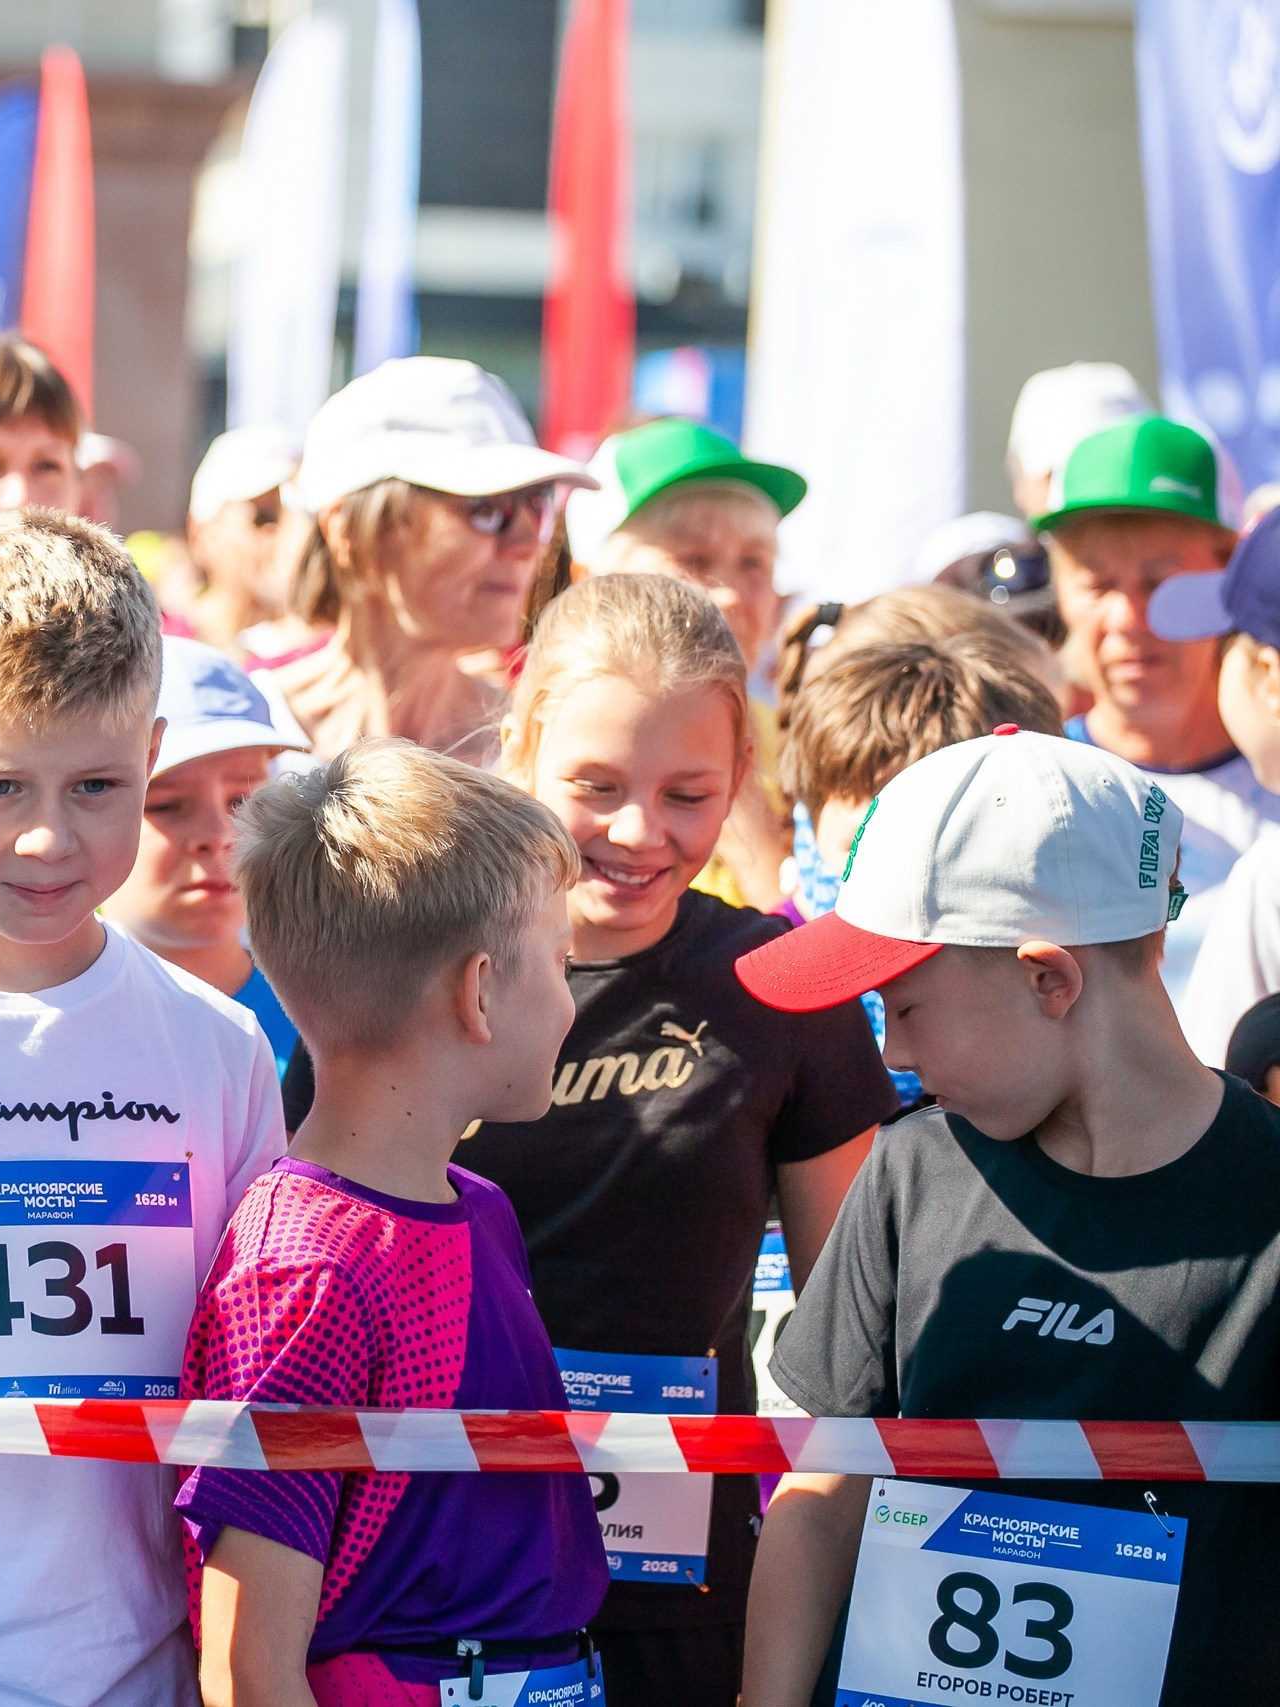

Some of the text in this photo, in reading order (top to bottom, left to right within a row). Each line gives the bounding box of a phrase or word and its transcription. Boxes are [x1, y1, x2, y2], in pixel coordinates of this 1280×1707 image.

[1139, 782, 1166, 888] FIFA WO
[552, 1046, 694, 1106] uma
[24, 1195, 76, 1208] МОСТЫ
[135, 1193, 166, 1206] 1628
[27, 1211, 74, 1220] МАРАФОН
[1002, 1297, 1114, 1345] FILA
[144, 1384, 175, 1397] 2026
[893, 1511, 928, 1527] СБЕР
[963, 1512, 1080, 1540] КРАСНОЯРСКИЕ
[992, 1530, 1046, 1548] МОСТЫ
[993, 1546, 1041, 1560] МАРАФОН
[1115, 1543, 1153, 1560] 1628
[641, 1560, 678, 1573] 2026
[928, 1571, 1075, 1680] 83
[917, 1671, 1075, 1707] ЕГОРОВ РОБЕРТ
